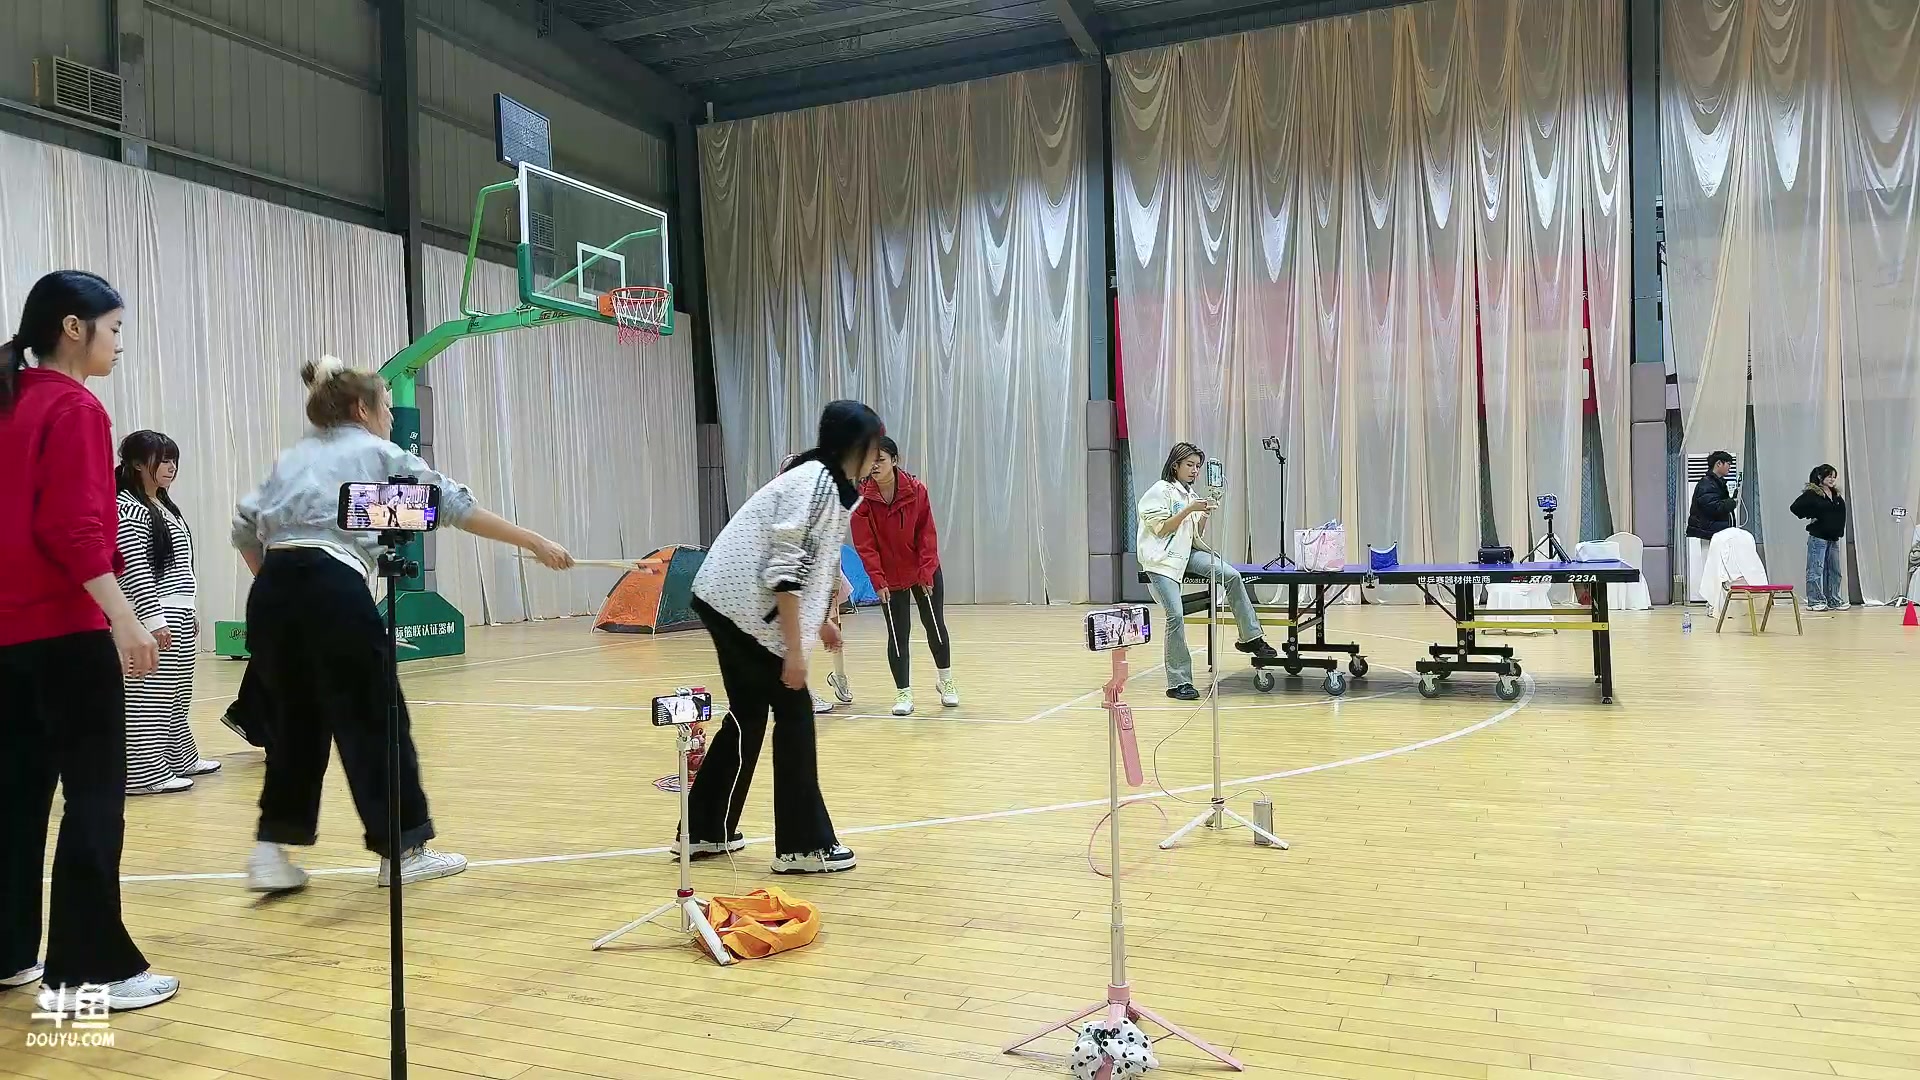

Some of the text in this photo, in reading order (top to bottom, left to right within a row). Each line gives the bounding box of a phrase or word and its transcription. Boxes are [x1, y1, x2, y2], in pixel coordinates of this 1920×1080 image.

[1417, 575, 1491, 585] 世乒赛器材供应商
[1567, 574, 1597, 583] 223A
[385, 621, 455, 640] 际篮联认证器材
